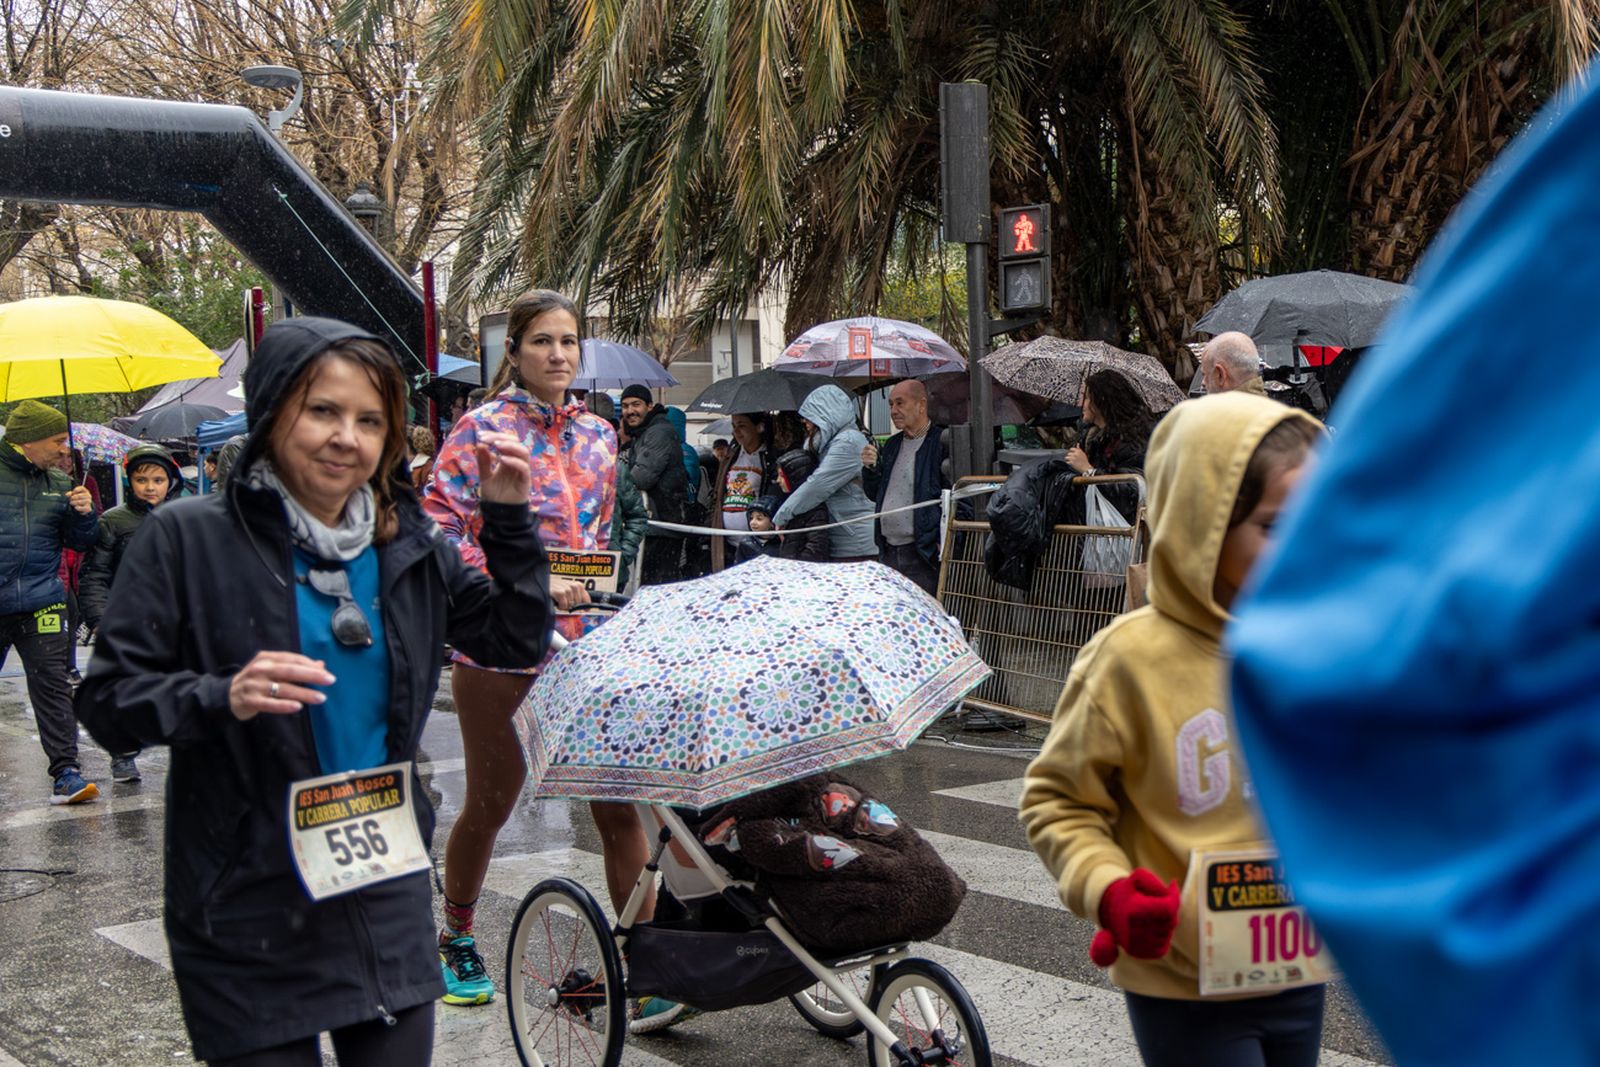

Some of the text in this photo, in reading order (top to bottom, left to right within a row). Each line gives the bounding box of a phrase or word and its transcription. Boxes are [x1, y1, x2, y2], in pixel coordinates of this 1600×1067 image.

[551, 563, 612, 575] CARRERA POPULAR
[560, 553, 575, 563] San
[575, 555, 591, 563] Juan
[591, 555, 611, 564] Bosco
[42, 617, 56, 627] LZ
[300, 775, 394, 806] IES San Juan Bosco
[297, 789, 400, 827] V CARRERA POPULAR
[325, 819, 388, 866] 556
[1216, 864, 1241, 884] IES
[1243, 863, 1274, 882] San
[1212, 882, 1296, 908] V CARRERA
